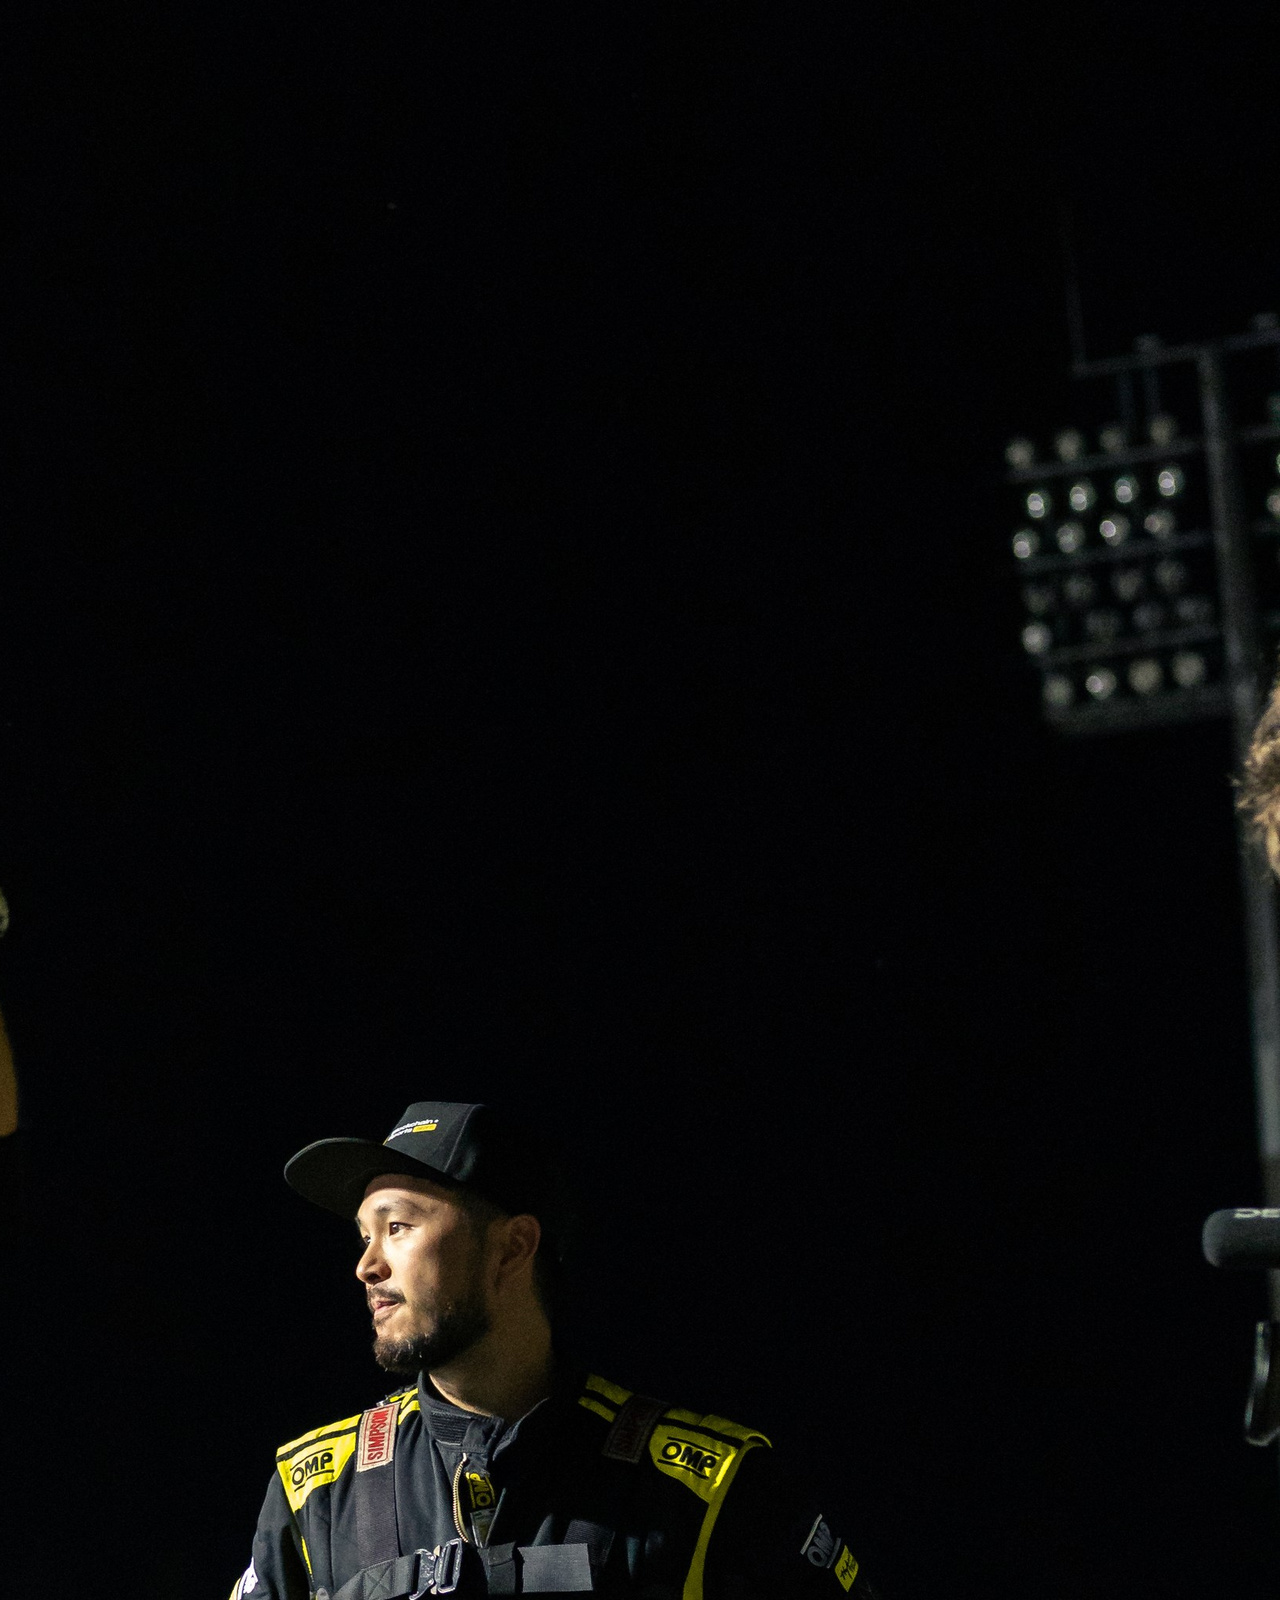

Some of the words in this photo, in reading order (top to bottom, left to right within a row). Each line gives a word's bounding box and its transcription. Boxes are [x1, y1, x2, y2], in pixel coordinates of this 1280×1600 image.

[367, 1409, 389, 1461] SIMPSON
[291, 1452, 333, 1486] OMP
[662, 1441, 717, 1472] OMP
[807, 1521, 835, 1568] OMP
